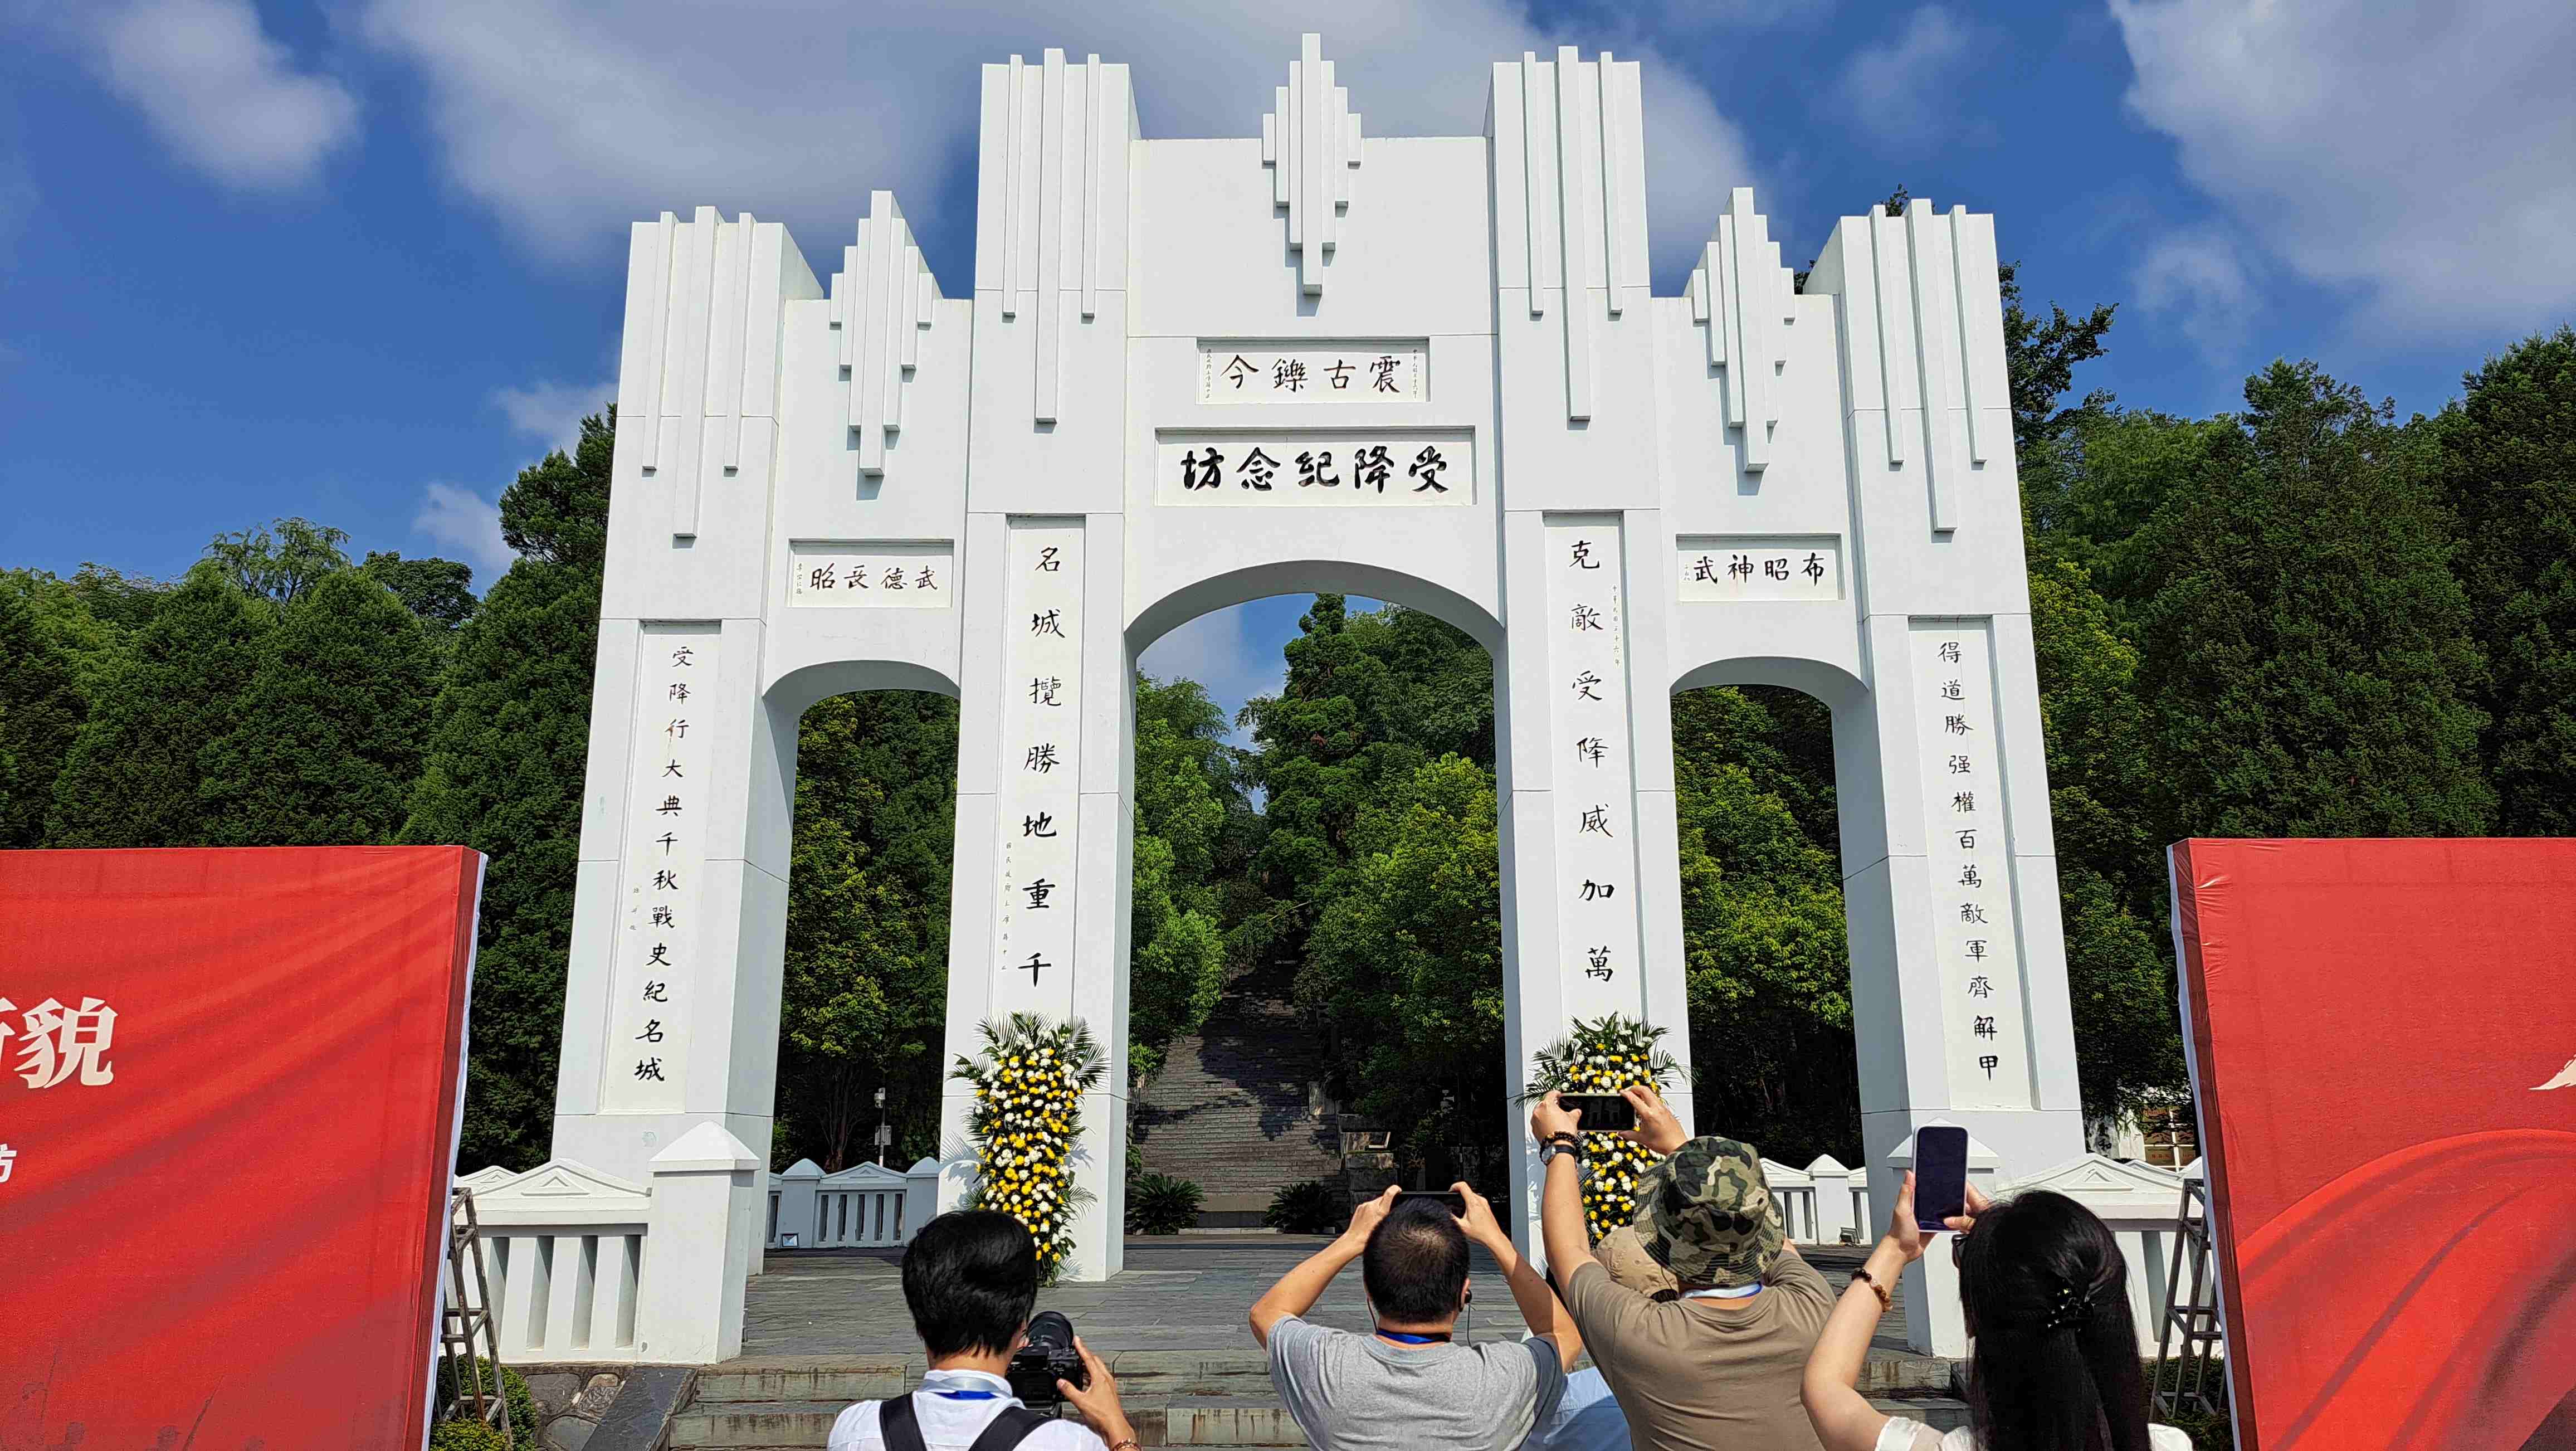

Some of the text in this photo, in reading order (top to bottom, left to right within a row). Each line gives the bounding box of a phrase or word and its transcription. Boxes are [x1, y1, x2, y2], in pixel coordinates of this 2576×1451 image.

[1222, 354, 1401, 393] 震古鑠今
[1180, 445, 1448, 494] 受降紀念坊
[1694, 552, 1824, 586] 布昭神武
